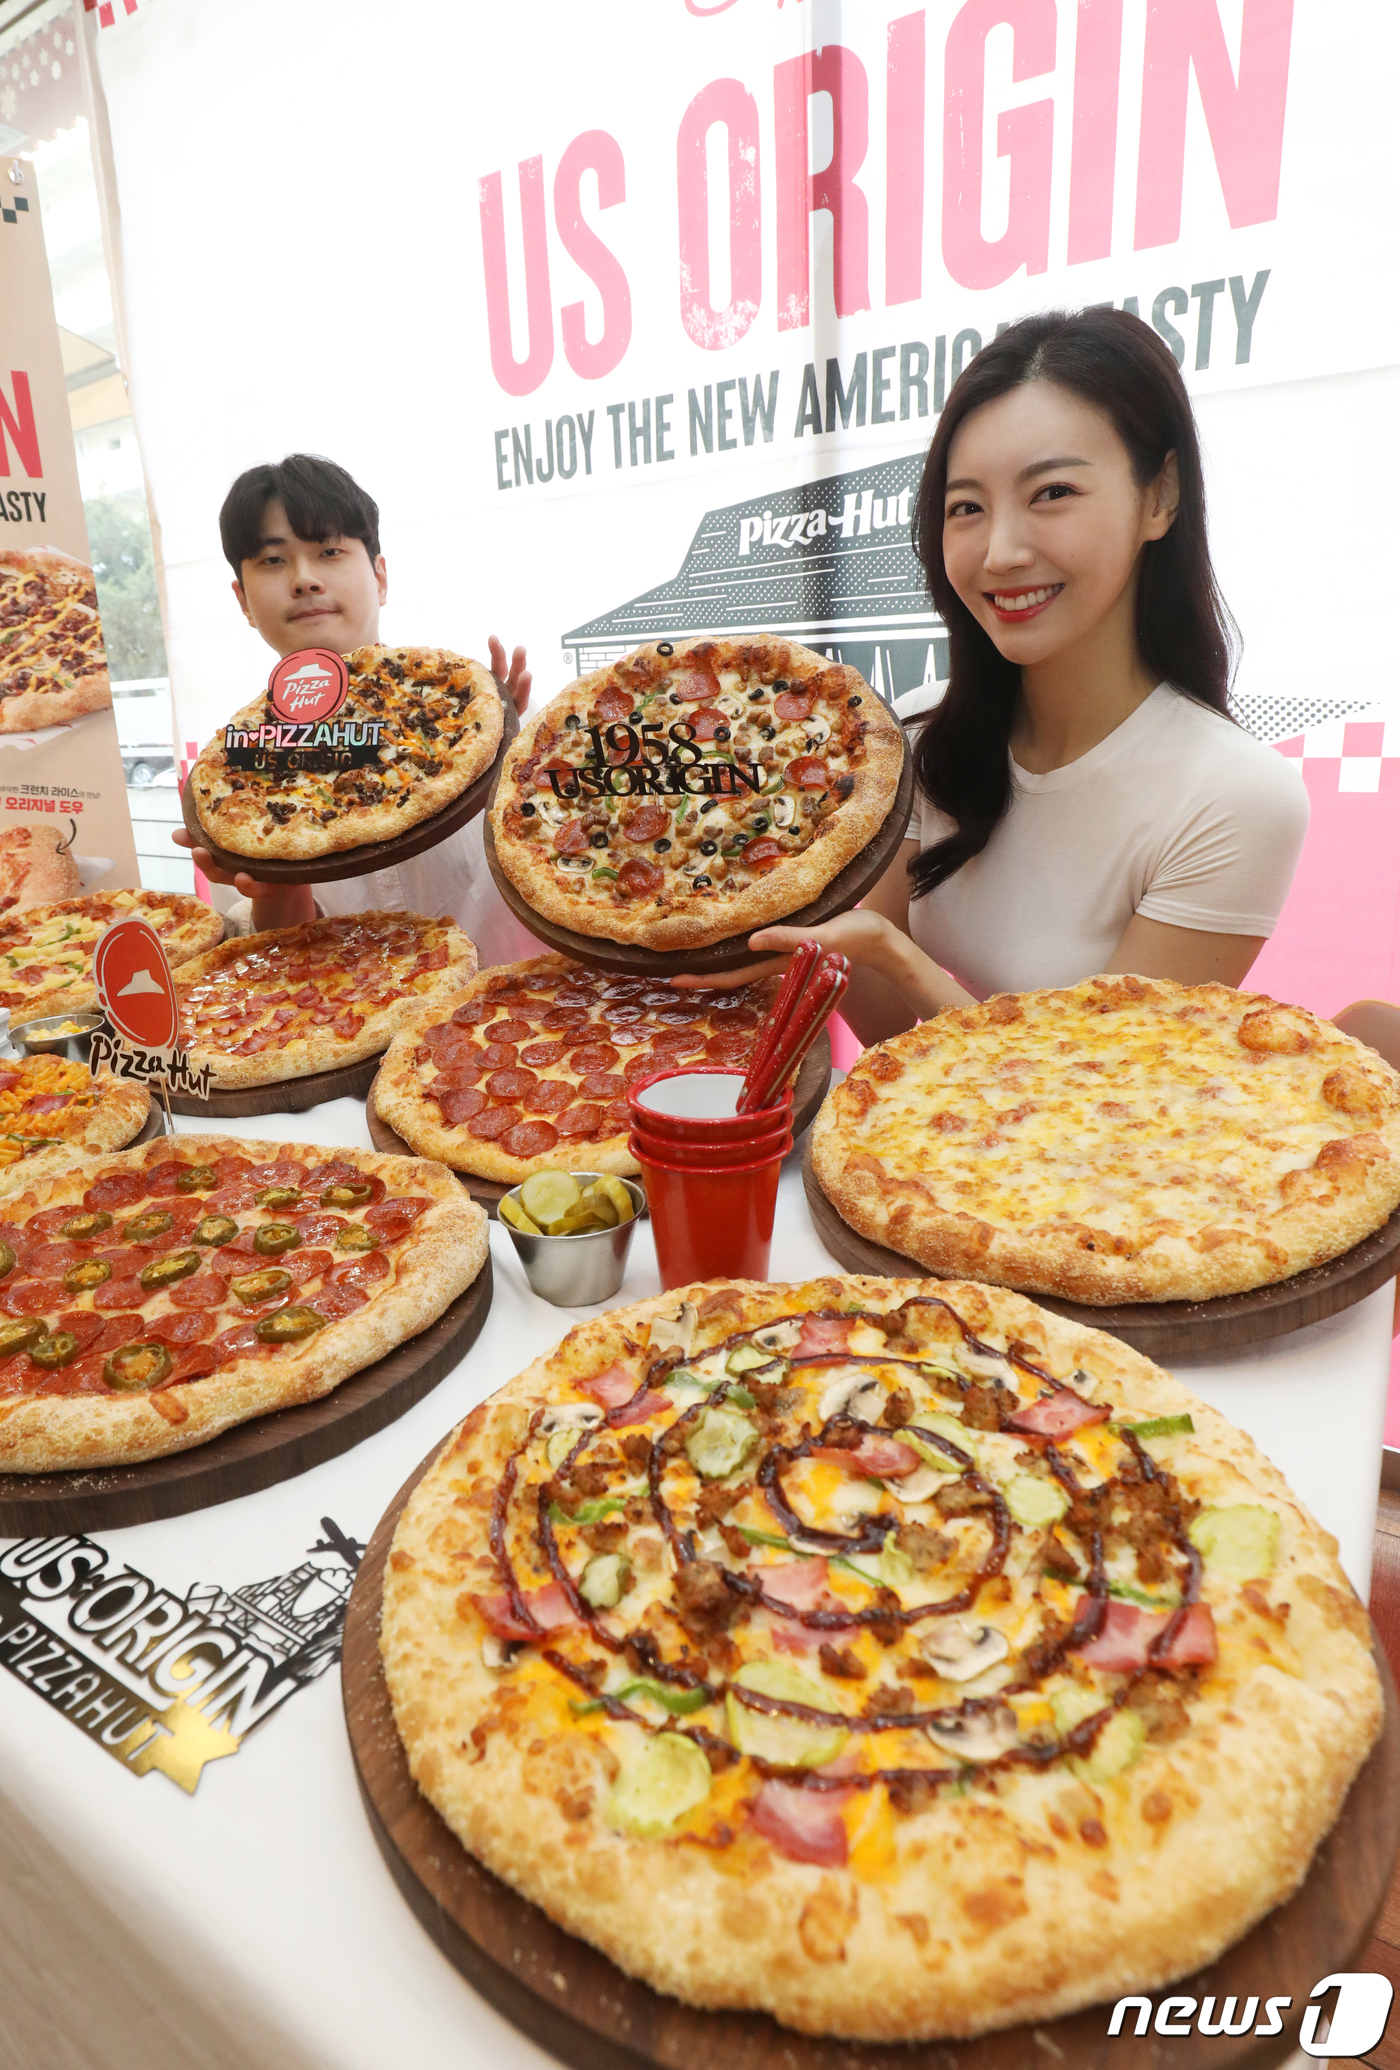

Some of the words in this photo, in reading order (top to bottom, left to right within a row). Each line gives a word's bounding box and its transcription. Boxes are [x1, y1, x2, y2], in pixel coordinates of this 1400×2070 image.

[477, 129, 633, 397] US
[676, 0, 1294, 351] ORIGIN
[494, 409, 595, 491] ENJOY
[606, 392, 675, 470] THE
[687, 369, 780, 455] NEW
[794, 321, 1010, 437] AMERIC
[1083, 268, 1272, 372] STY
[282, 678, 330, 700] Pizza
[290, 692, 326, 712] Hut
[584, 721, 703, 768] 1958
[5, 796, 55, 813] 오리지널
[59, 800, 84, 814] 도우
[20, 784, 49, 796] 크런치
[90, 1035, 166, 1083] Pizza
[167, 1049, 218, 1100] Hut
